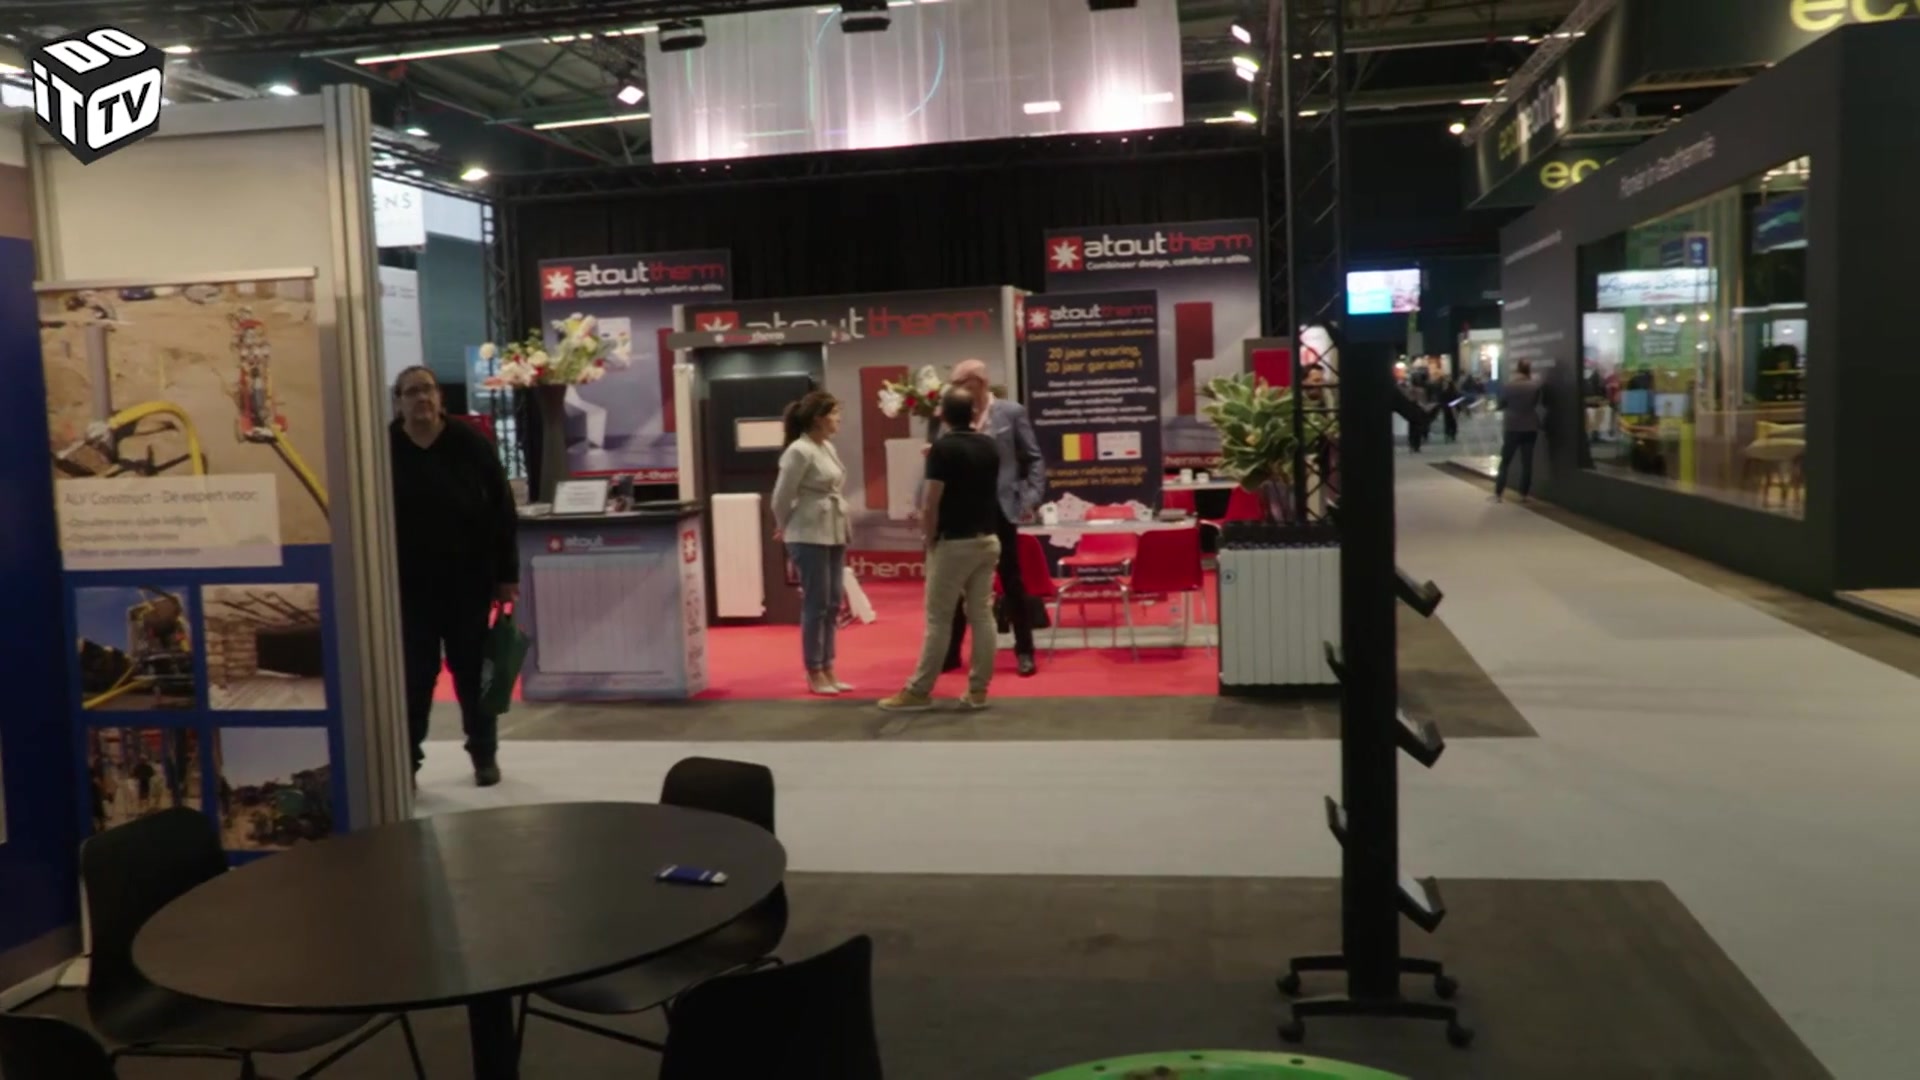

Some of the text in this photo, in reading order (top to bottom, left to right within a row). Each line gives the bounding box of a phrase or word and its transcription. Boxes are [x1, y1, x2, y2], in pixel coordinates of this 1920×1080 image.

[1540, 158, 1617, 189] ec
[1048, 347, 1063, 360] 20
[1064, 348, 1087, 362] jaar
[1045, 361, 1060, 374] 20
[1061, 362, 1085, 375] jaar
[1087, 359, 1136, 374] garantie
